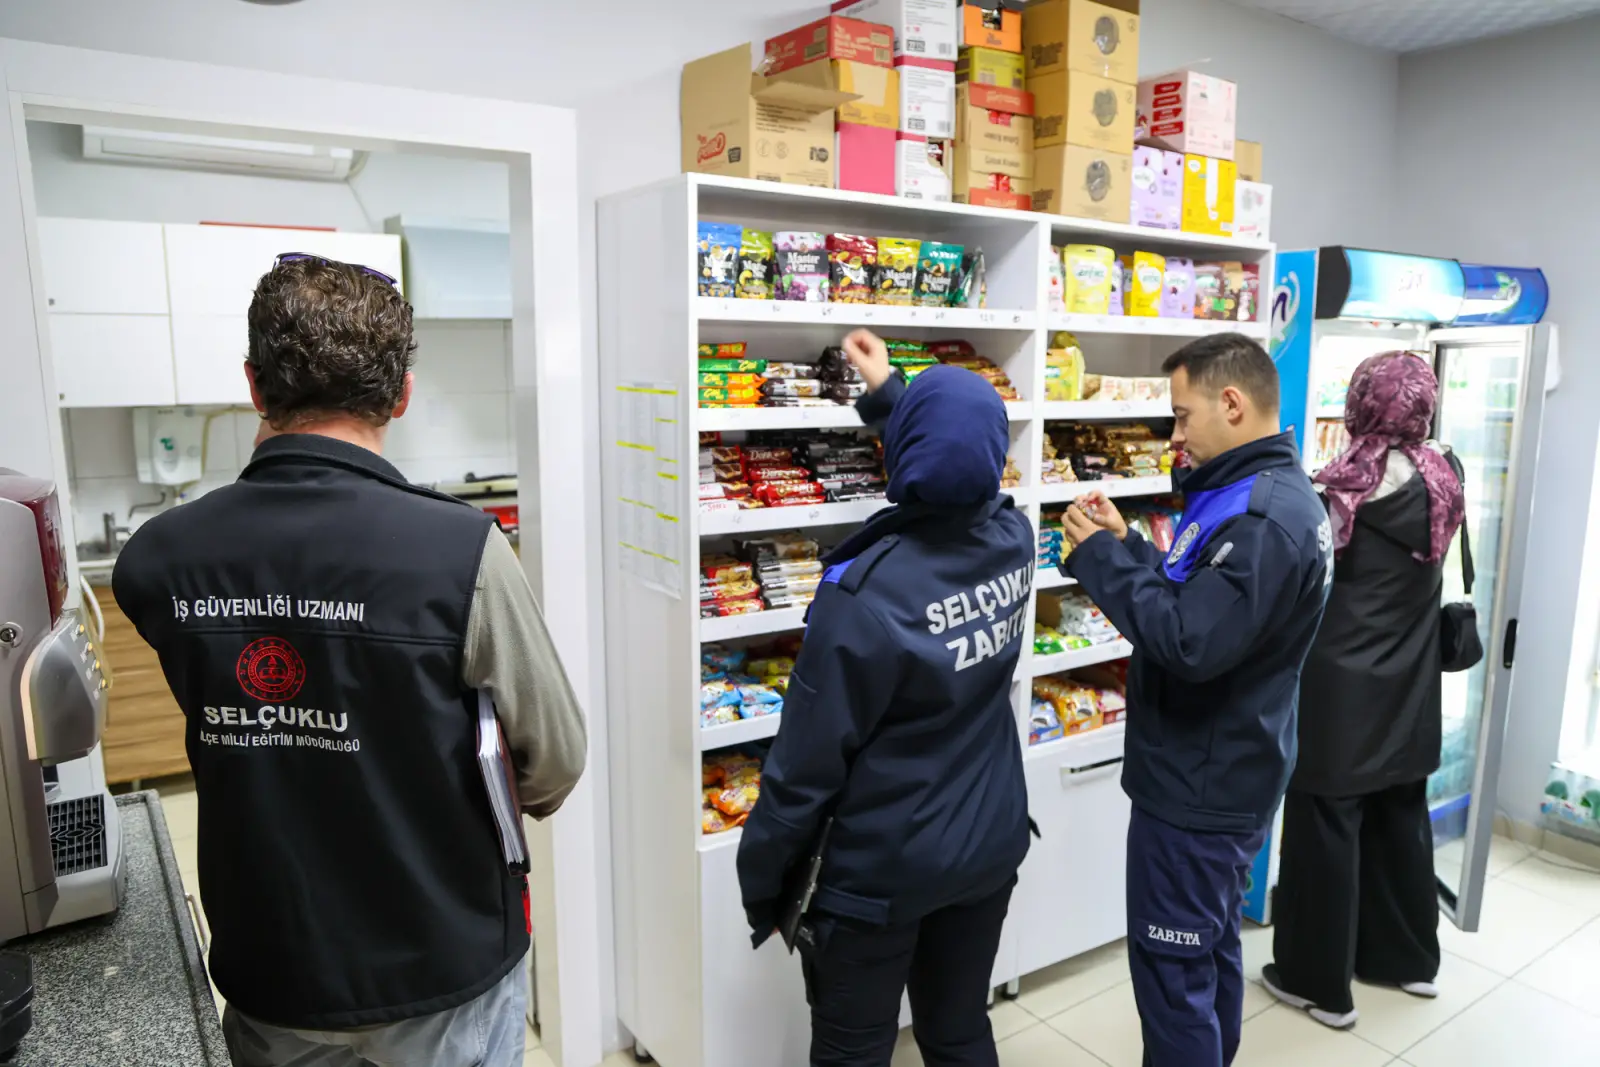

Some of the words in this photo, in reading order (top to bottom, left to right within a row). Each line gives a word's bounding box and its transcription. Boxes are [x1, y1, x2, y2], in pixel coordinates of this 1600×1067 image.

[786, 252, 820, 265] Master
[172, 596, 189, 622] İŞ
[194, 594, 292, 618] GÜVENLİĞİ
[297, 599, 365, 622] UZMANI
[926, 559, 1035, 635] SELÇUKLU
[203, 705, 348, 733] SELÇUKLU
[221, 732, 251, 747] MİLLİ
[252, 731, 293, 747] EĞİTİM
[1148, 925, 1201, 946] ZABITA
